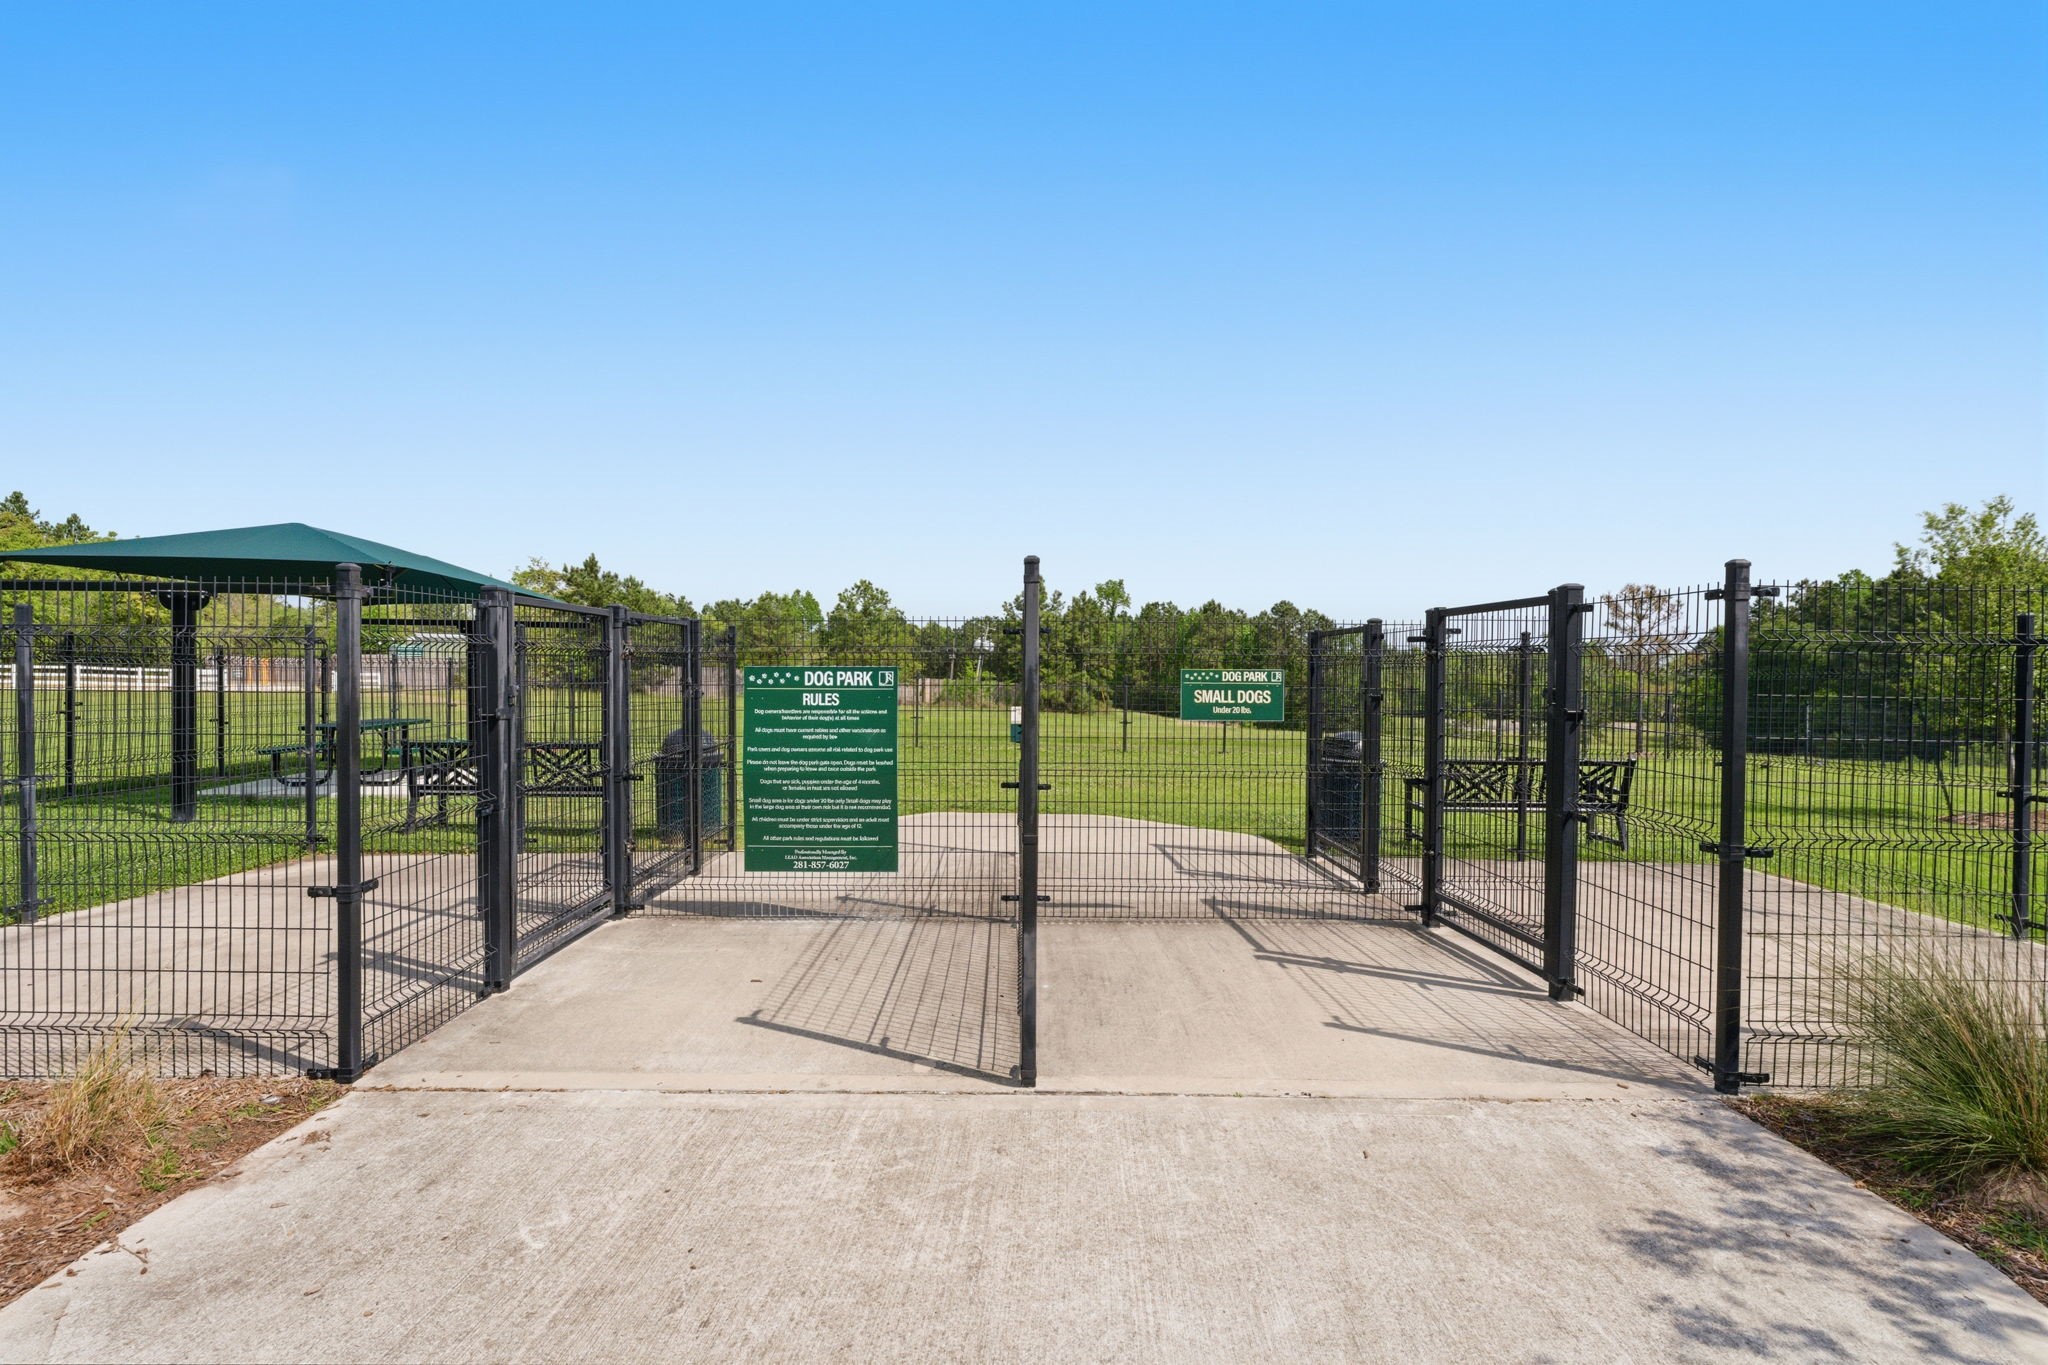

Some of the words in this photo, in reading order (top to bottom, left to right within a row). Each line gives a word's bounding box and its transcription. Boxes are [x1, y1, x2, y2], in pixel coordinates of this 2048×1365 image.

[804, 671, 834, 686] DOG
[836, 671, 874, 686] PARK
[1222, 672, 1242, 682] DOG
[1243, 672, 1268, 682] PARK
[802, 693, 840, 706] RULES
[1194, 690, 1236, 704] SMALL
[1237, 690, 1272, 704] DOGS
[1212, 706, 1232, 714] Under
[1232, 706, 1240, 714] 20
